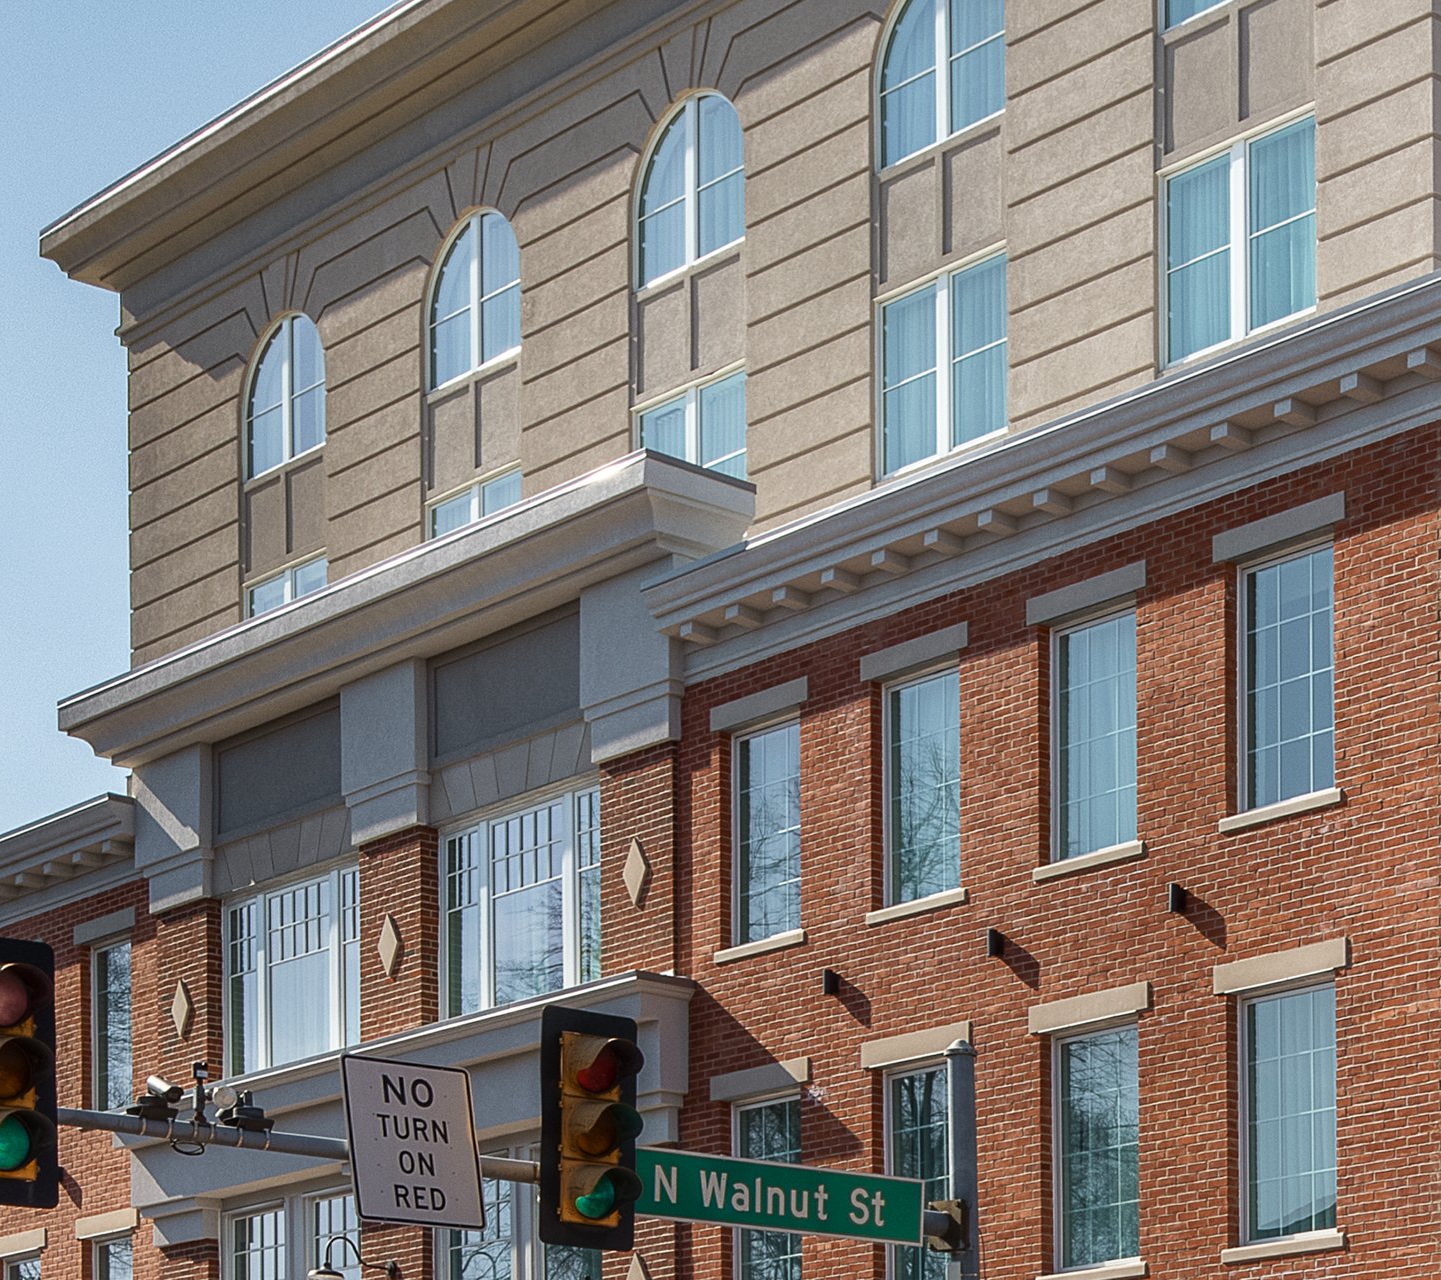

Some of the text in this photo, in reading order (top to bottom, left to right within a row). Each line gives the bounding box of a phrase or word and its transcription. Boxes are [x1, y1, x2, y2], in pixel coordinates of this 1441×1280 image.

[381, 1073, 434, 1109] NO
[376, 1113, 449, 1144] TURN
[398, 1150, 435, 1177] ON
[393, 1183, 447, 1212] RED
[653, 1164, 886, 1227] N Walnut St
